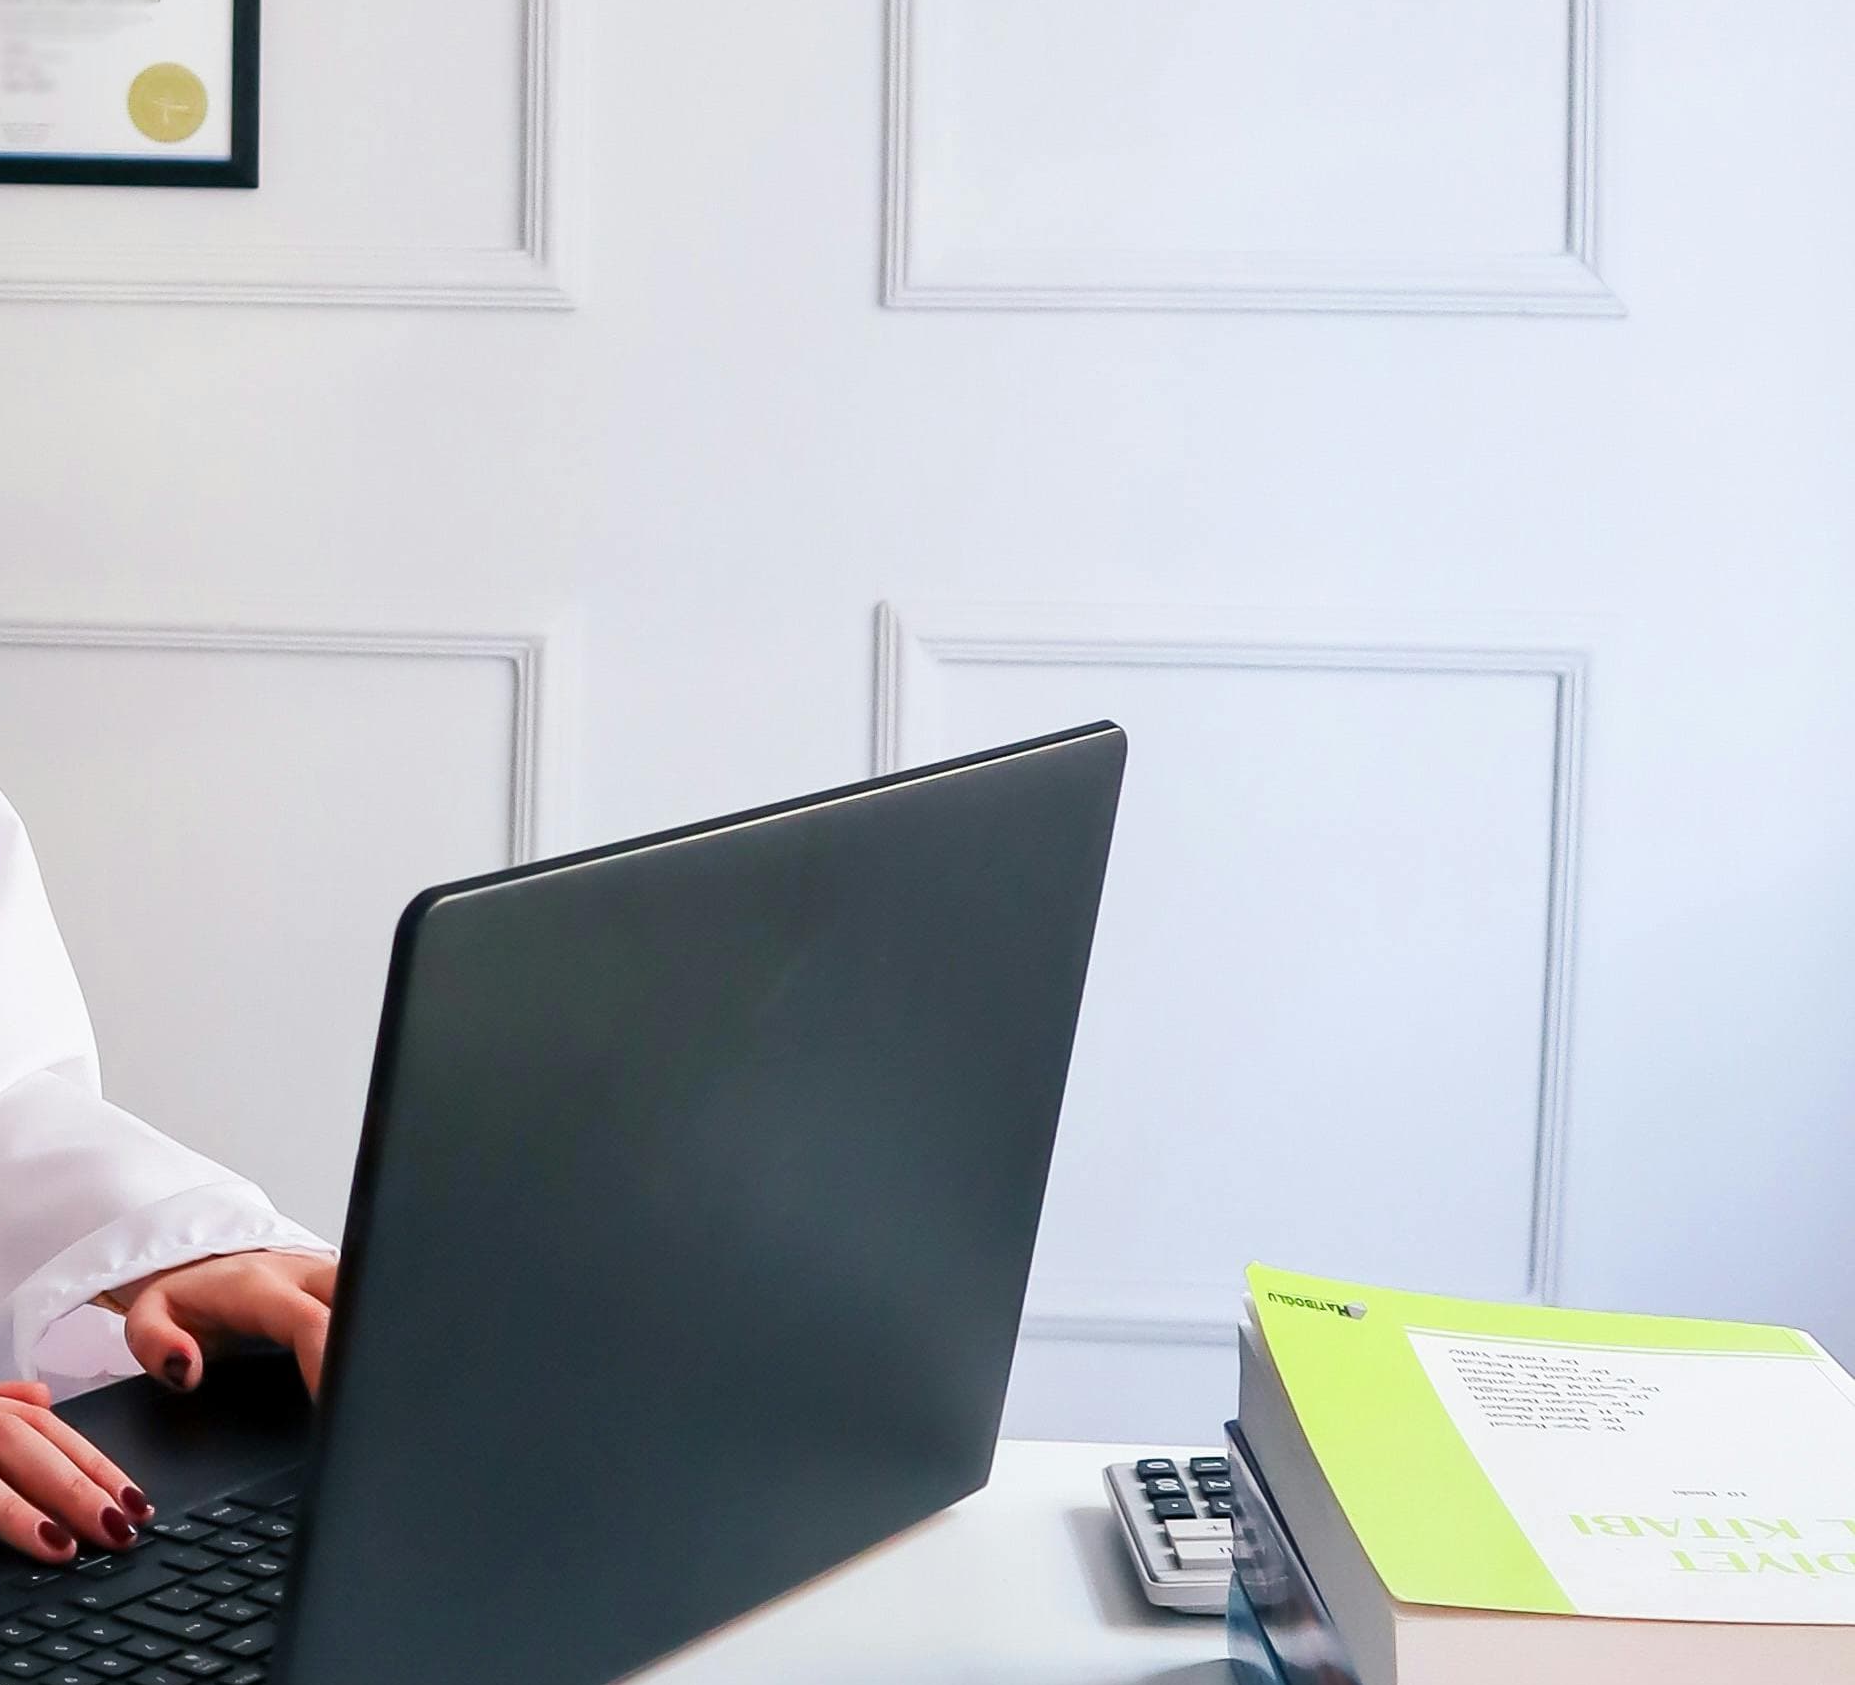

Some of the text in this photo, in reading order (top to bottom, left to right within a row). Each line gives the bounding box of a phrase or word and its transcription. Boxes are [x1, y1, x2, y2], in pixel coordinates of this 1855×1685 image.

[1146, 1461, 1170, 1469] 0
[1208, 1480, 1231, 1489] 2
[1569, 1514, 1802, 1544] KİTABI
[1671, 1550, 1855, 1579] DİYET
